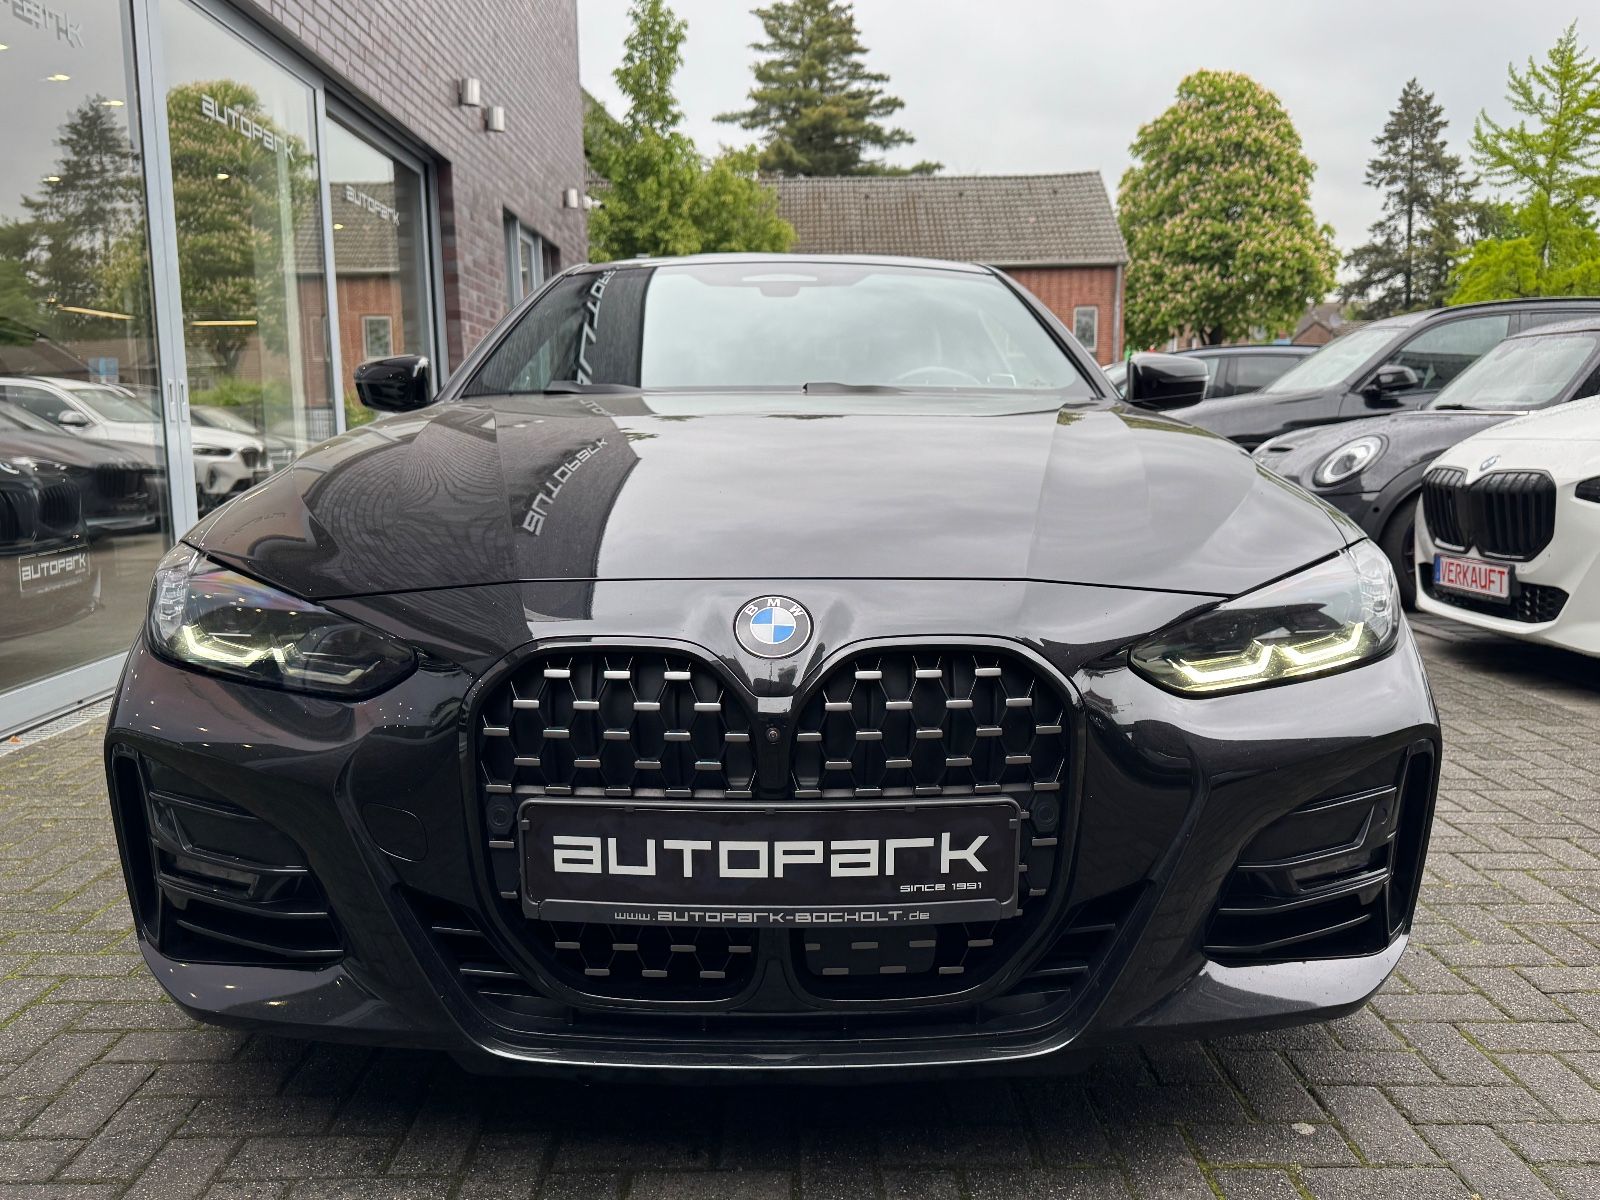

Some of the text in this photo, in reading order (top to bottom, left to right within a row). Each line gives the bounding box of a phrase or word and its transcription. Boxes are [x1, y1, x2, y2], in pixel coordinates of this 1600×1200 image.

[1441, 560, 1506, 593] VERKAUFT
[744, 598, 805, 617] BMW
[899, 881, 982, 893] since 1991
